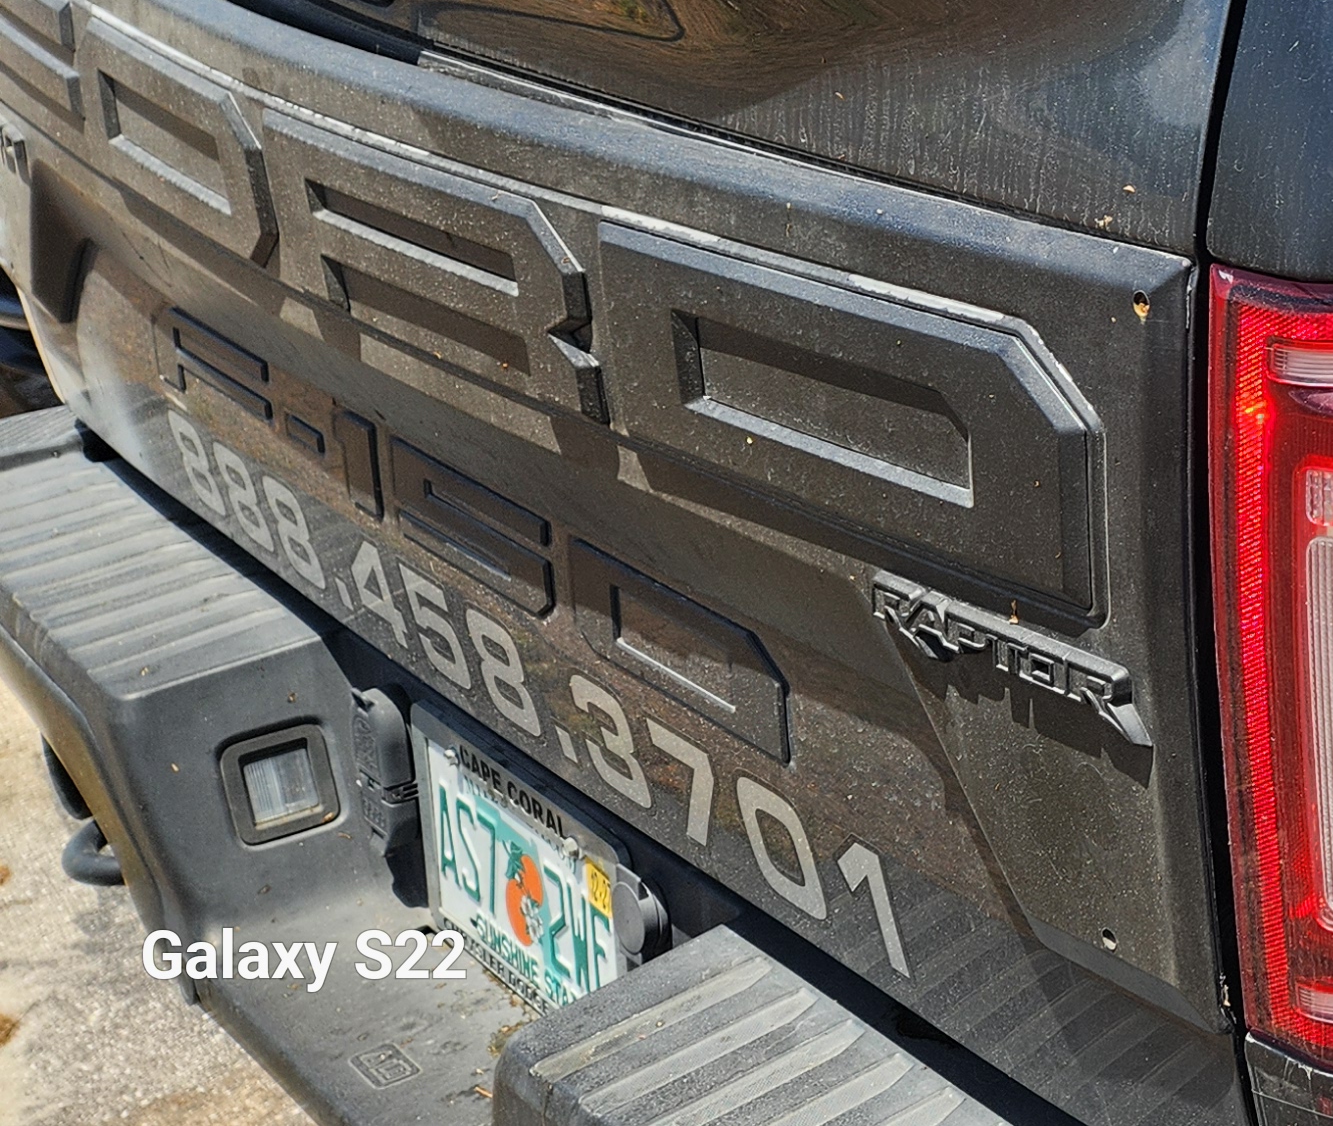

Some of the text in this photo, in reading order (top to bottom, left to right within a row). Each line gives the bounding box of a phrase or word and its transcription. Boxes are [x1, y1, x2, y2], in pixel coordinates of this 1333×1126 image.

[871, 569, 1153, 747] RAPTOR
[459, 744, 503, 793] CAPE
[507, 780, 568, 839] CORAL
[474, 913, 540, 987] SUNSHINE
